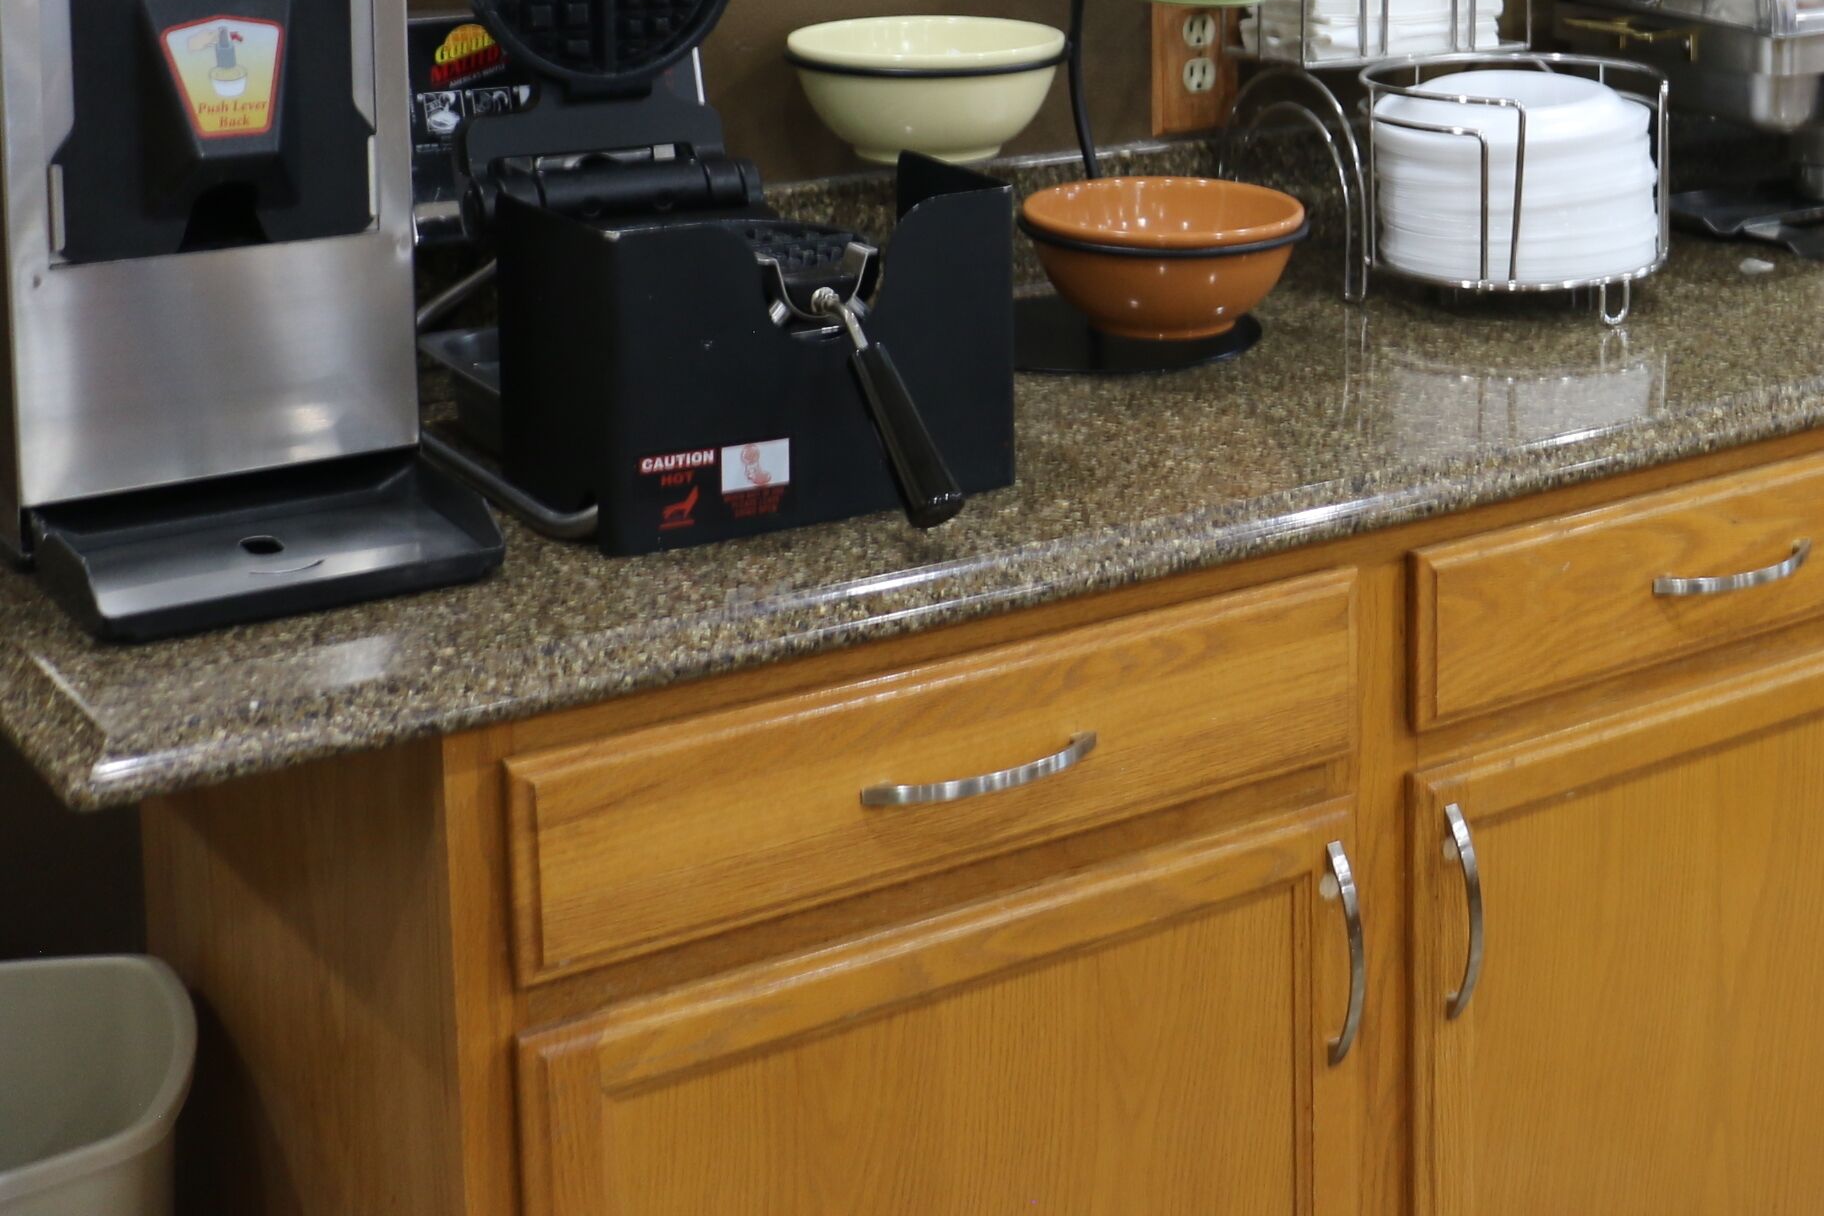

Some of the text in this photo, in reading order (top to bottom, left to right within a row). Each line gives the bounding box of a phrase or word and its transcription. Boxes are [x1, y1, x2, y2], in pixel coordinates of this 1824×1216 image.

[198, 99, 268, 115] Push Lever
[218, 114, 250, 129] Back
[641, 449, 715, 474] CAUTION
[660, 471, 694, 486] HOT
